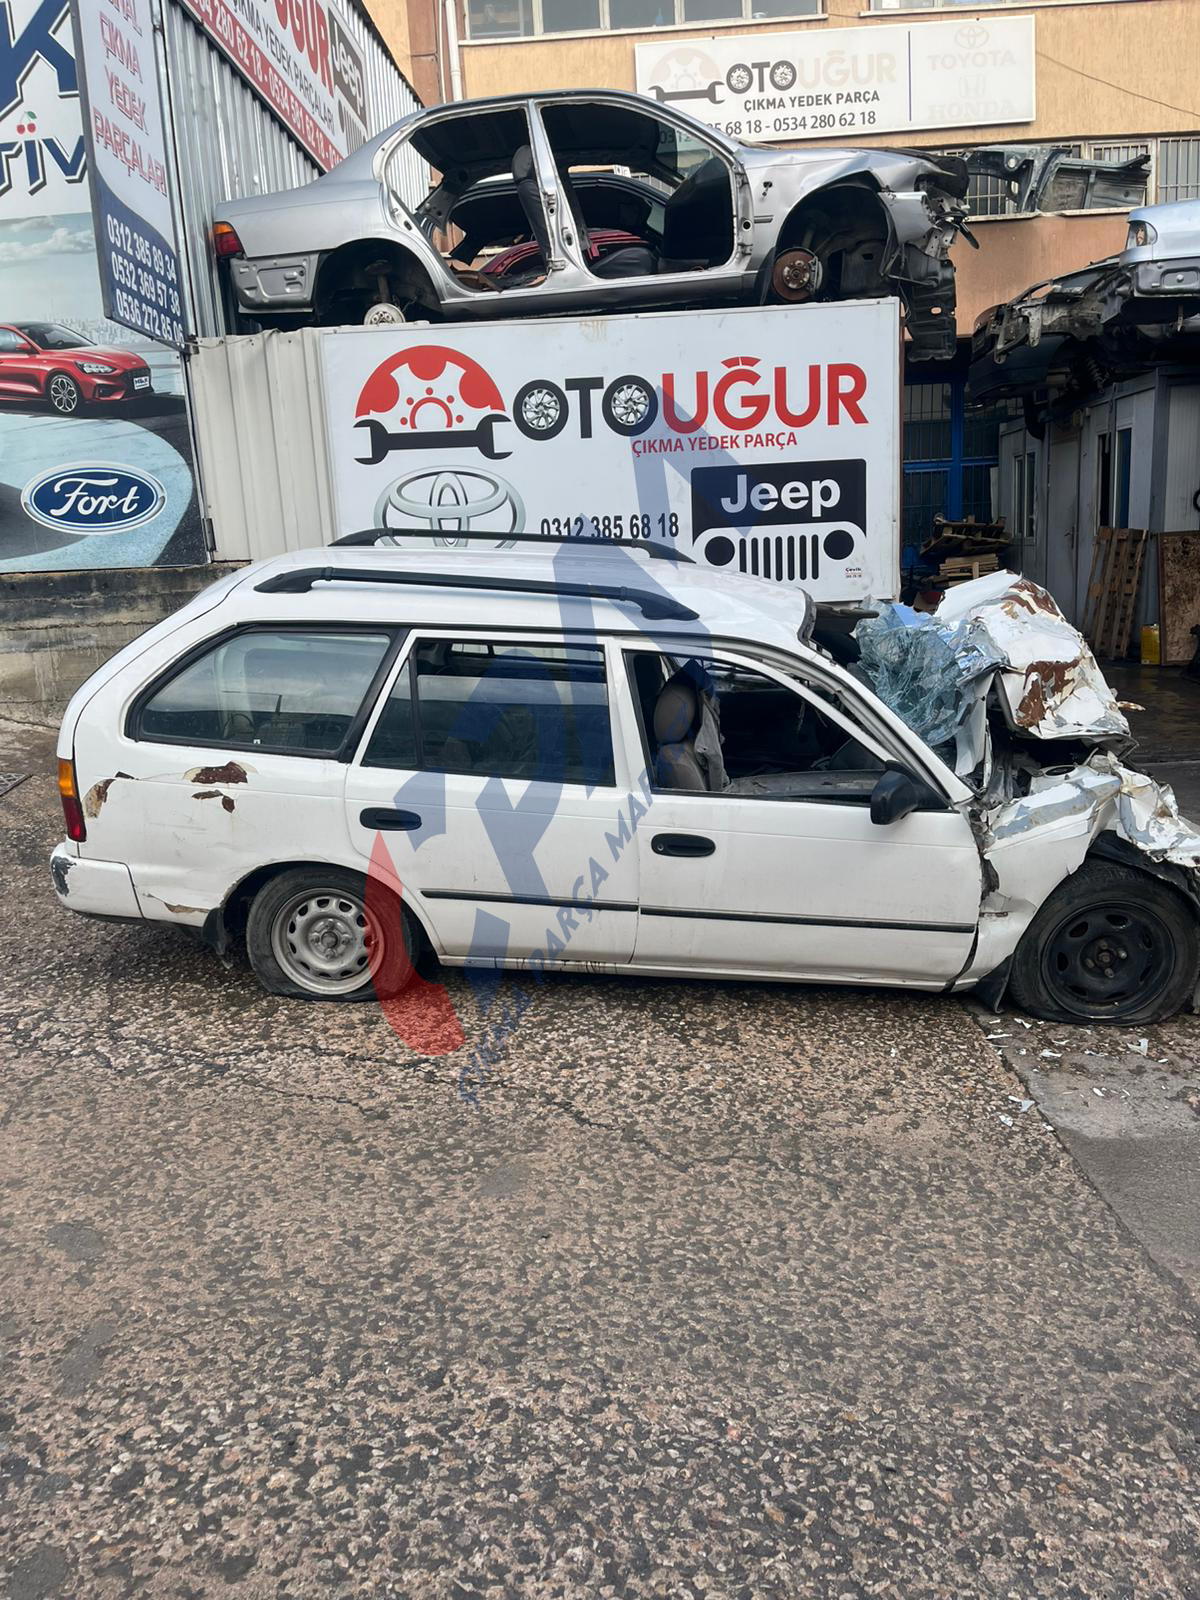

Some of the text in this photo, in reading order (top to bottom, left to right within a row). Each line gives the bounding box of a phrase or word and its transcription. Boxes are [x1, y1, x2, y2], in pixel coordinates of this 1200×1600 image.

[99, 11, 143, 84] ÇIKMA
[236, 25, 249, 67] 62
[263, 16, 293, 80] YEDEK
[332, 20, 364, 115] Jeep
[927, 50, 1017, 71] TOYOTA
[104, 64, 149, 136] YEDEK
[743, 90, 880, 112] ÇIKMA YEDEK PARÇA
[928, 99, 1016, 121] HONDA
[725, 120, 743, 136] 68
[747, 119, 763, 134] 18
[773, 117, 808, 132] 0534
[811, 113, 836, 128] 280
[839, 112, 856, 127] 62
[860, 110, 877, 125] 18
[92, 106, 168, 198] PARÇALARI
[107, 213, 177, 284] 0312 385 89 34
[111, 251, 181, 317] 0532 369 57 38
[115, 288, 142, 326] 0536
[142, 303, 161, 336] 272
[161, 313, 173, 342] 85
[631, 431, 798, 458] ÇIKMA YEDEK PARÇA
[50, 477, 140, 516] Fort
[720, 474, 841, 518] Jeep
[540, 512, 679, 539] 0312 385 68 18
